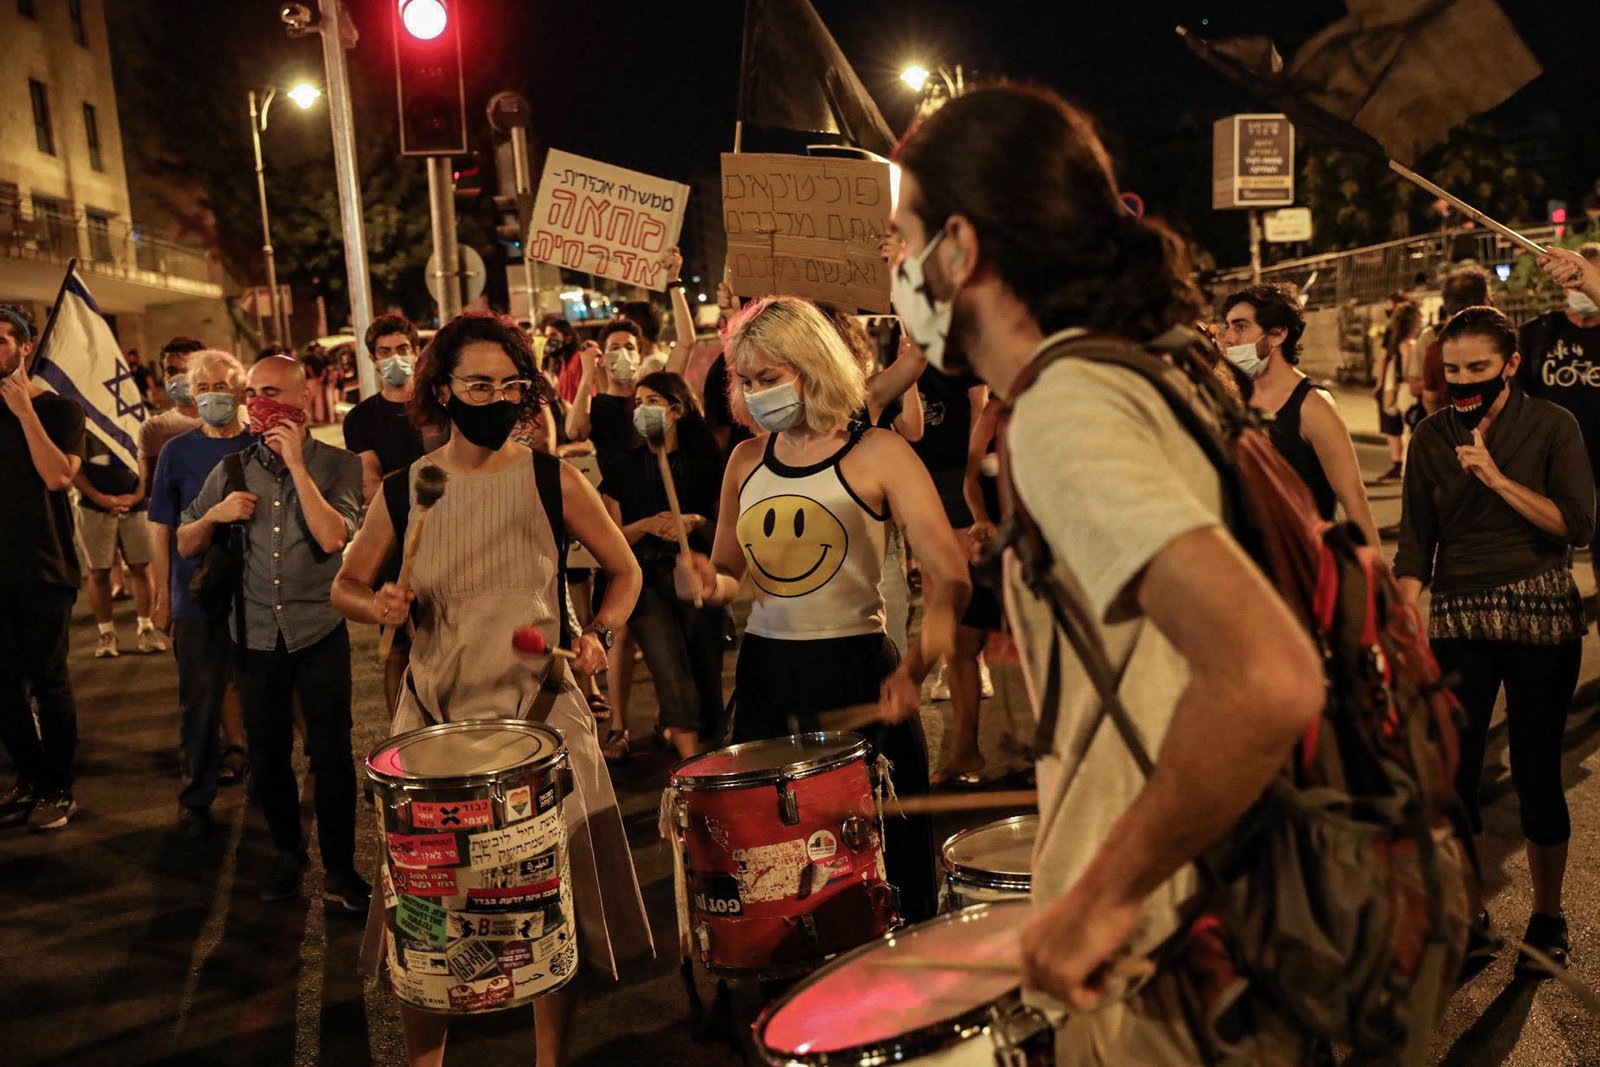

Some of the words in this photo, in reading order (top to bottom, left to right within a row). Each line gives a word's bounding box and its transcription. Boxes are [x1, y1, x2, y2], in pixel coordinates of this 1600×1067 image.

[618, 183, 674, 212] ממשלה
[724, 164, 881, 212] פוליטיקאים
[548, 188, 665, 253] מחאה
[726, 210, 816, 238] מדברים
[828, 214, 887, 243] אתם
[530, 230, 661, 287] אזרחית
[805, 258, 877, 287] ואנשים
[463, 802, 488, 812] כבוד
[464, 815, 489, 825] עצמי
[517, 825, 534, 836] חיל
[539, 813, 556, 830] אשת
[471, 831, 510, 850] לובשת
[498, 835, 545, 863] שמתחשק
[708, 897, 741, 913] GOT
